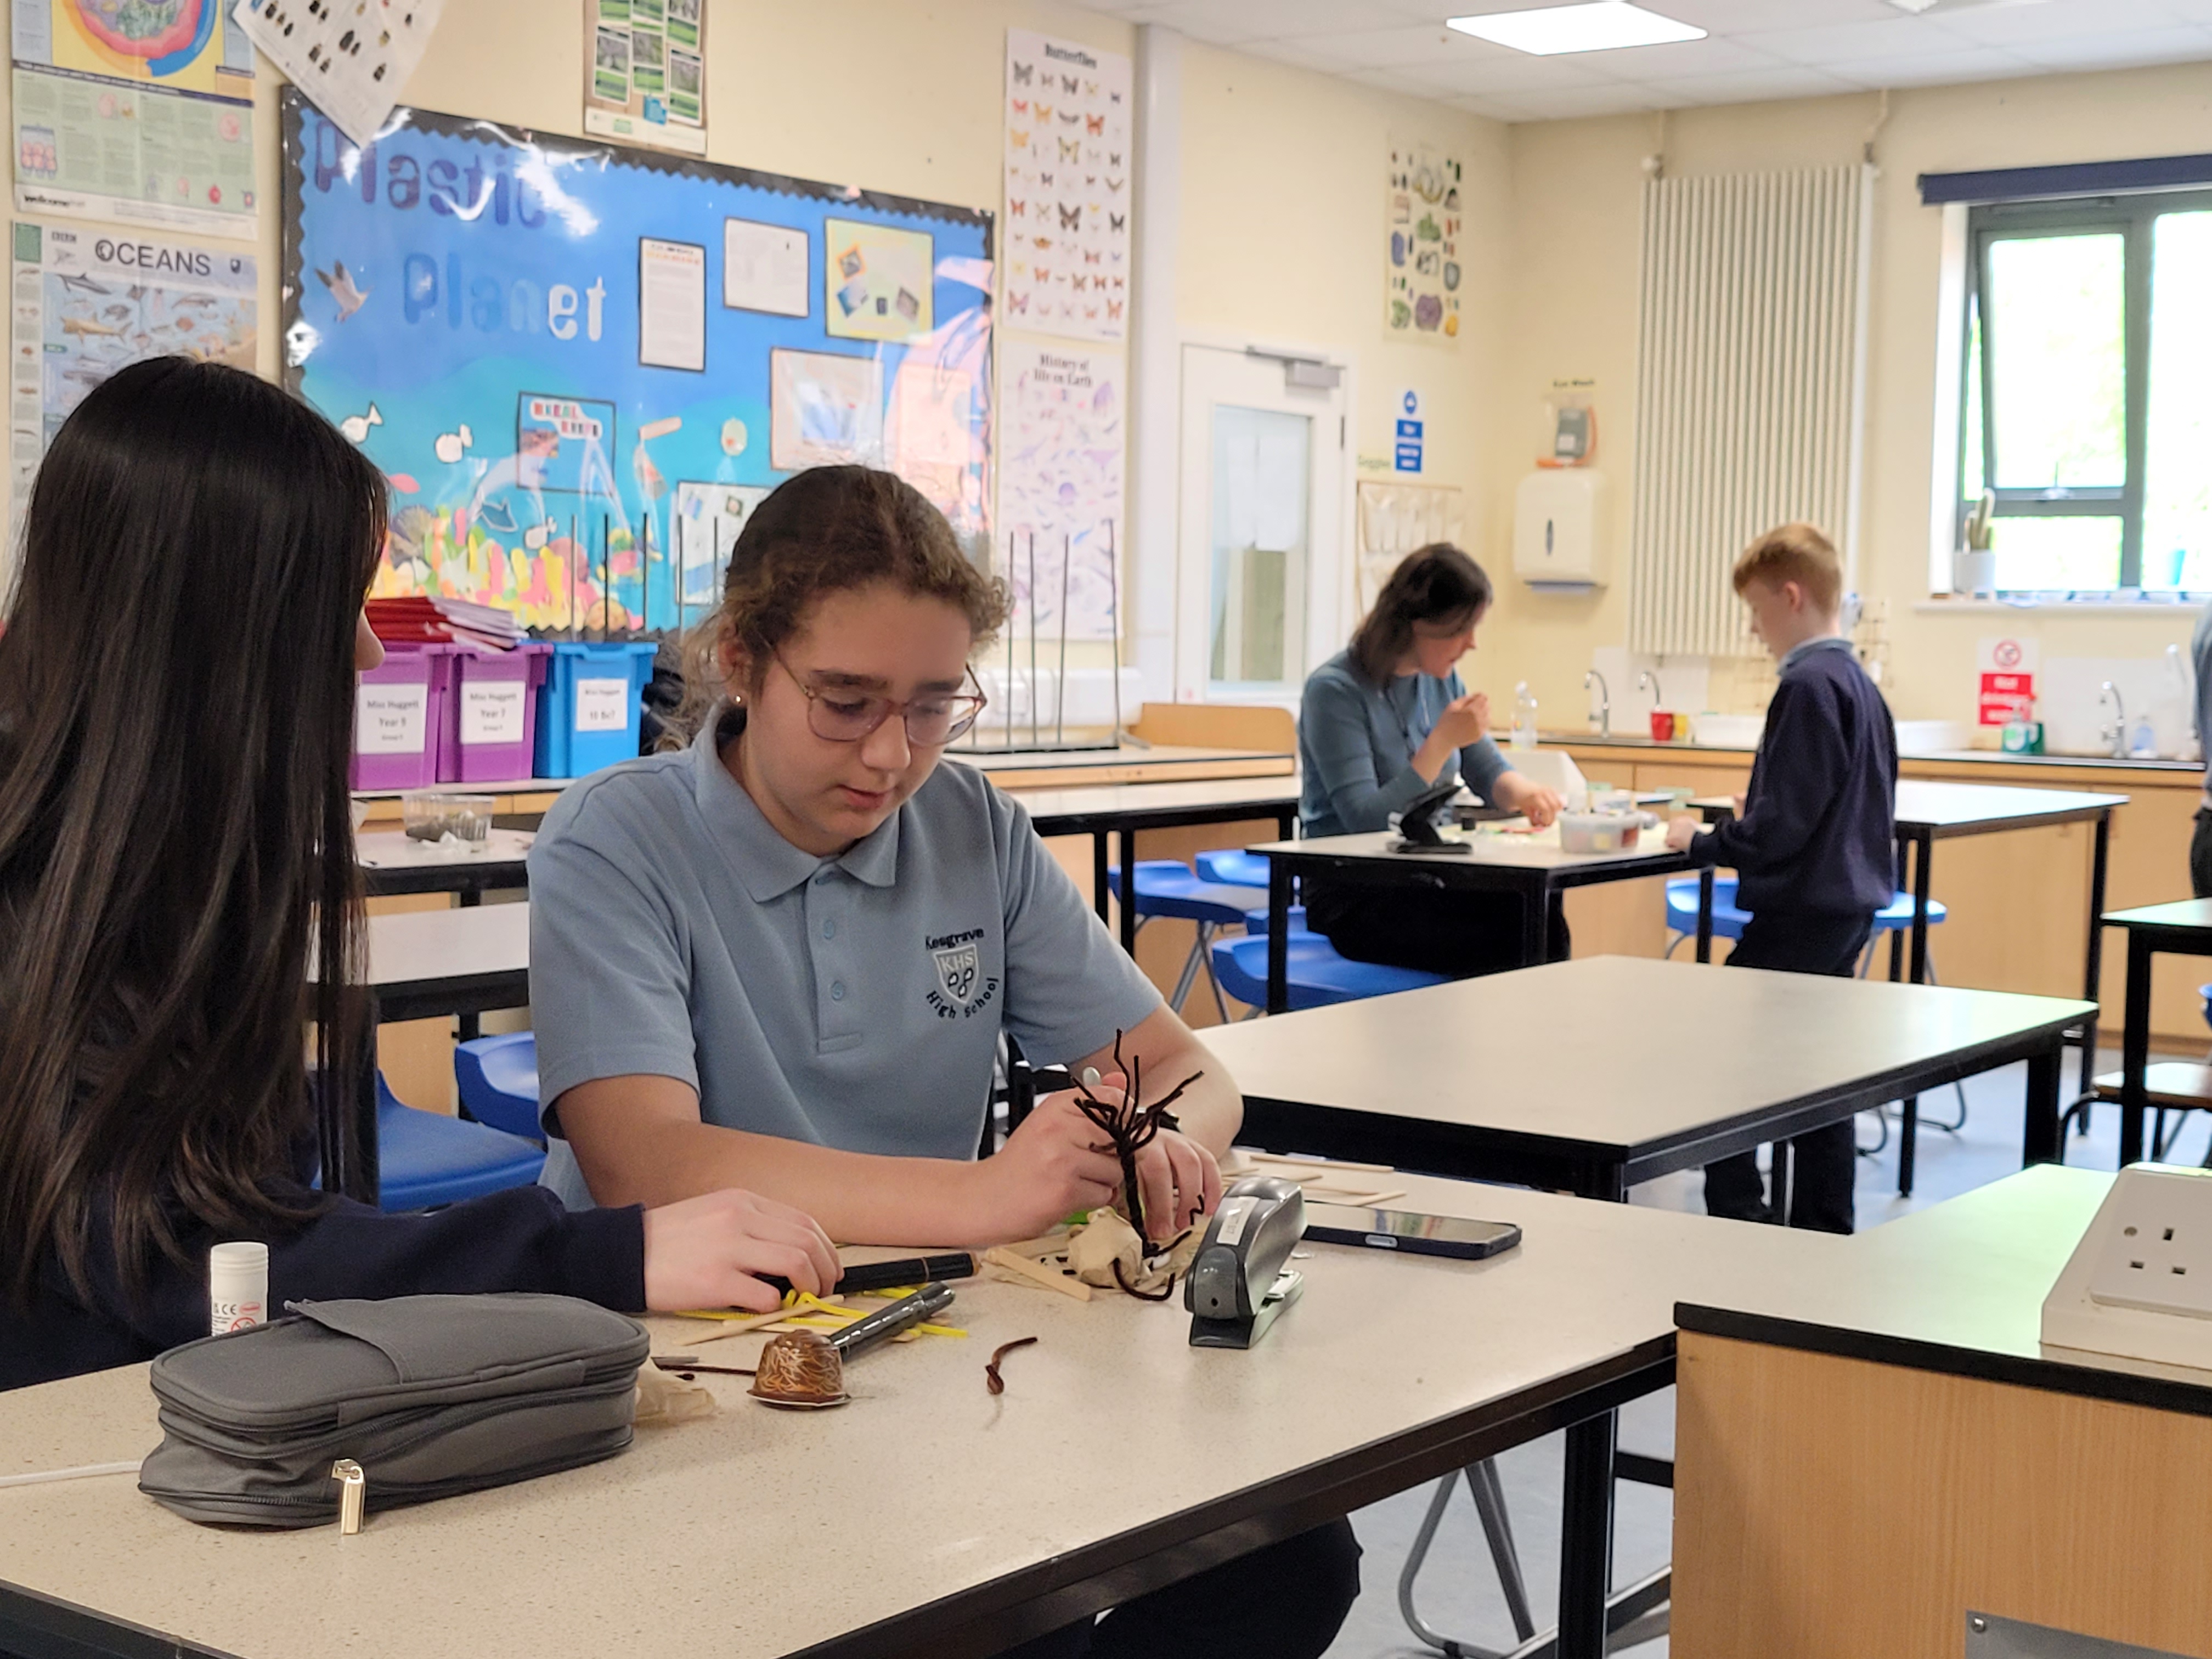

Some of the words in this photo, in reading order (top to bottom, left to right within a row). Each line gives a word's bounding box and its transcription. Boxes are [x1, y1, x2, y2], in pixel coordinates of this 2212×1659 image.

[95, 240, 211, 276] OCEANS
[404, 252, 606, 341] Planet
[939, 952, 974, 973] KHS
[926, 990, 957, 1019] High
[964, 977, 1000, 1018] School
